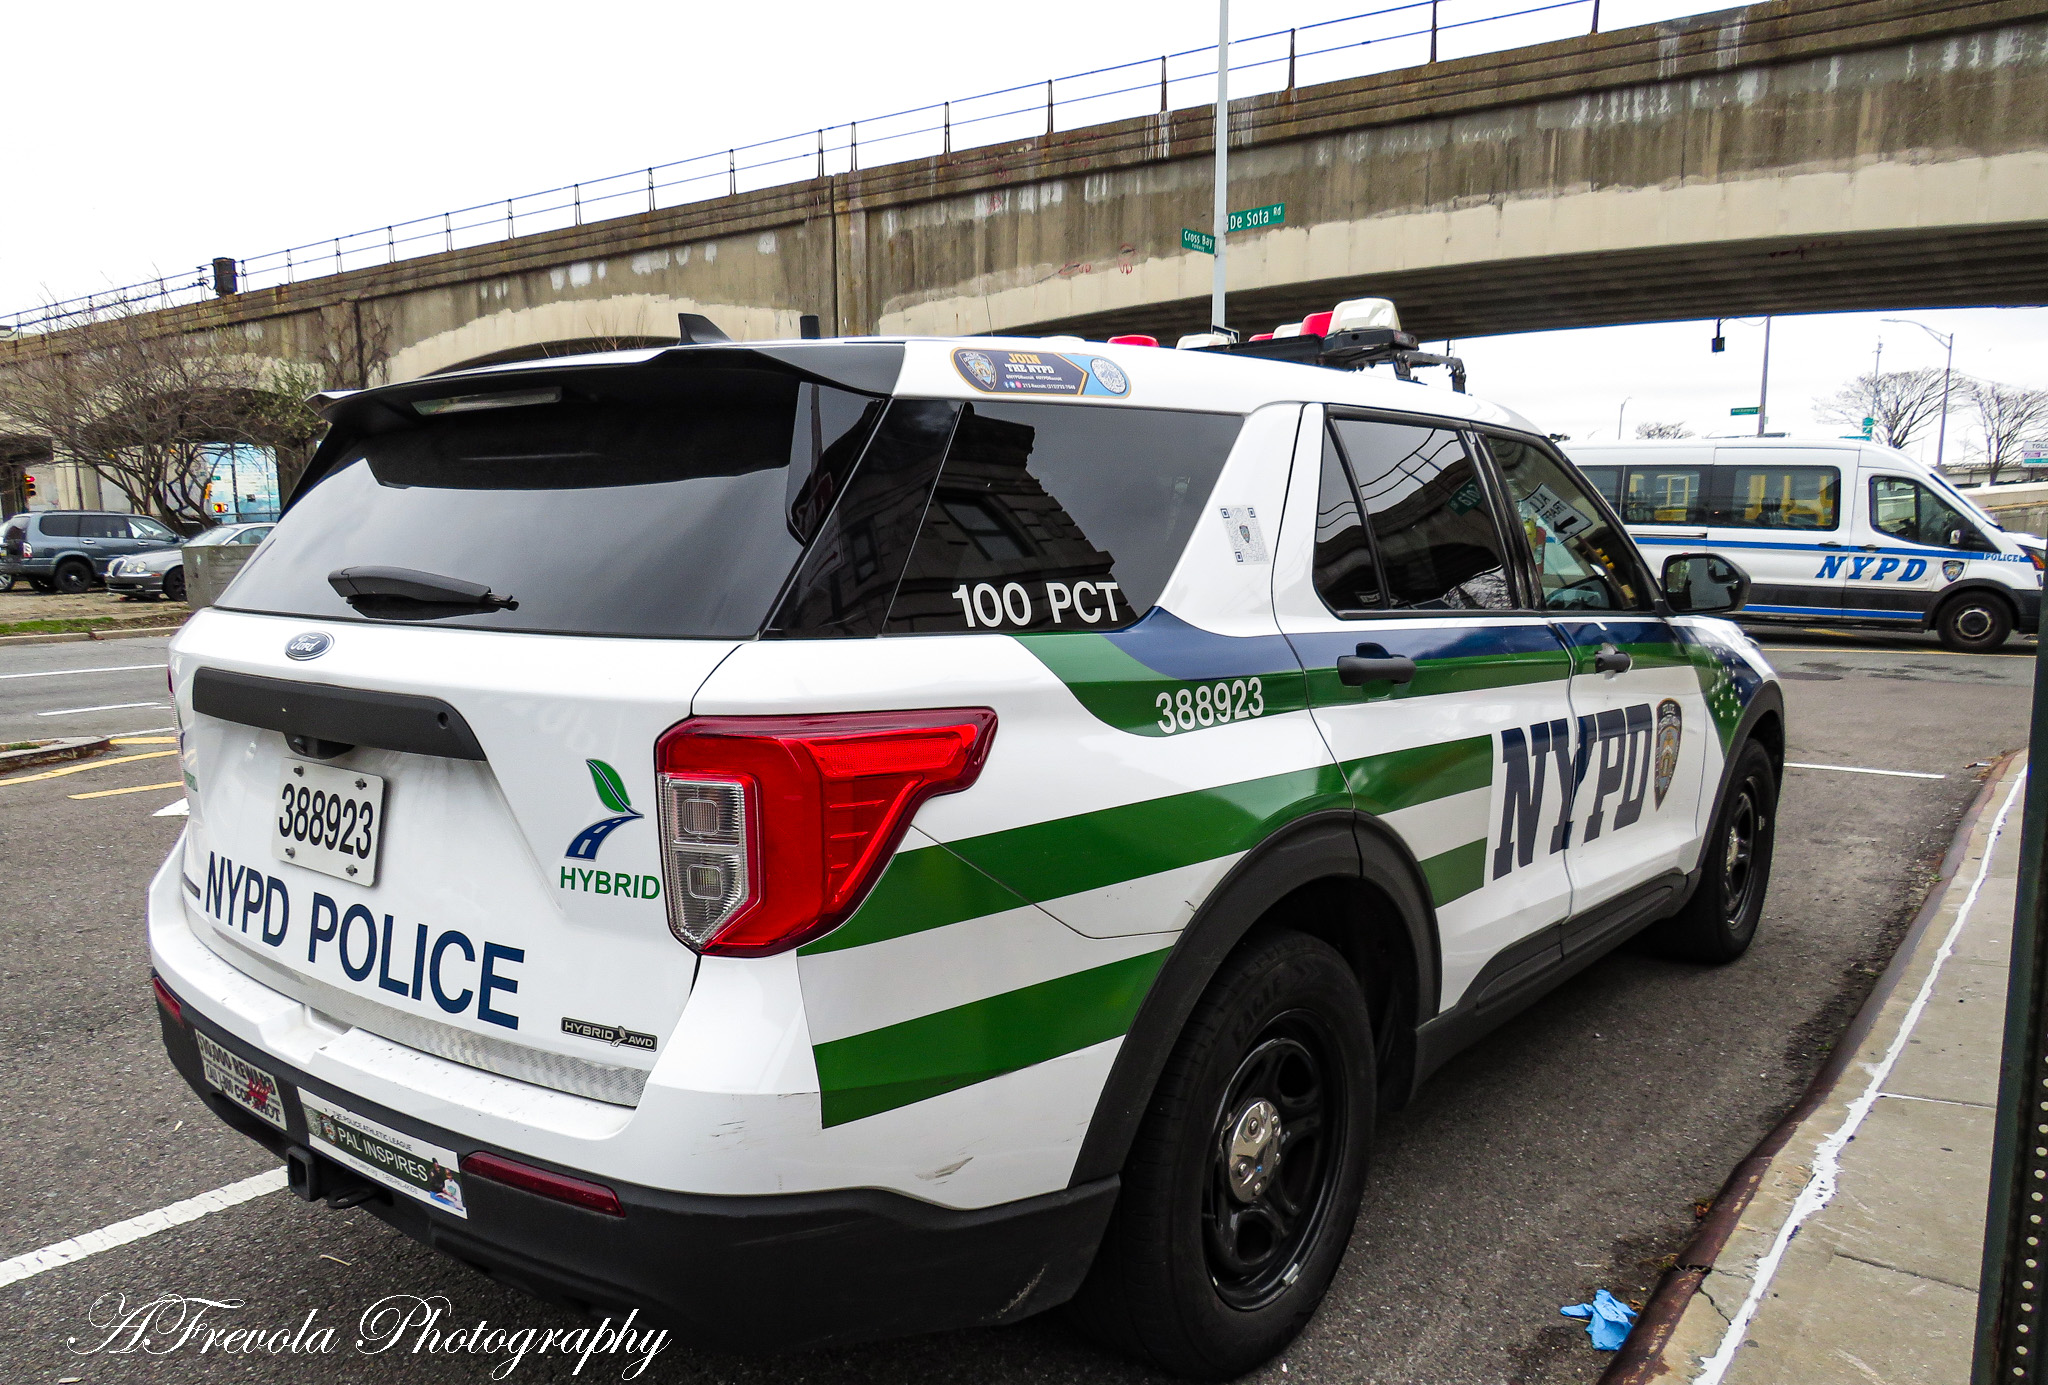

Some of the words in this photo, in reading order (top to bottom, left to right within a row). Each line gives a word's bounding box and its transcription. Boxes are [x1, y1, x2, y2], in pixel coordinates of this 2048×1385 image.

[1230, 215, 1242, 230] De
[1246, 209, 1269, 227] Sota
[1273, 205, 1282, 216] Rd
[1184, 230, 1201, 245] Cross
[1201, 234, 1213, 250] Bay
[1004, 363, 1027, 373] THE
[1027, 365, 1055, 374] NYPD
[1008, 353, 1041, 365] JOIN
[1815, 556, 1928, 583] NYPD
[1983, 553, 2020, 562] POLICE
[952, 582, 1032, 628] 100
[1046, 581, 1118, 624] PCT
[290, 635, 321, 652] Ford
[1155, 676, 1265, 735] 388923
[1493, 702, 1653, 882] NYPD
[279, 783, 374, 860] 388923
[560, 866, 661, 900] HYBRID
[205, 850, 290, 948] NYPD
[307, 891, 525, 1031] POLICE
[564, 1021, 614, 1042] HYBRID
[628, 1035, 655, 1048] AWD
[337, 1126, 363, 1152] PAL
[362, 1138, 429, 1182] INSPIRES
